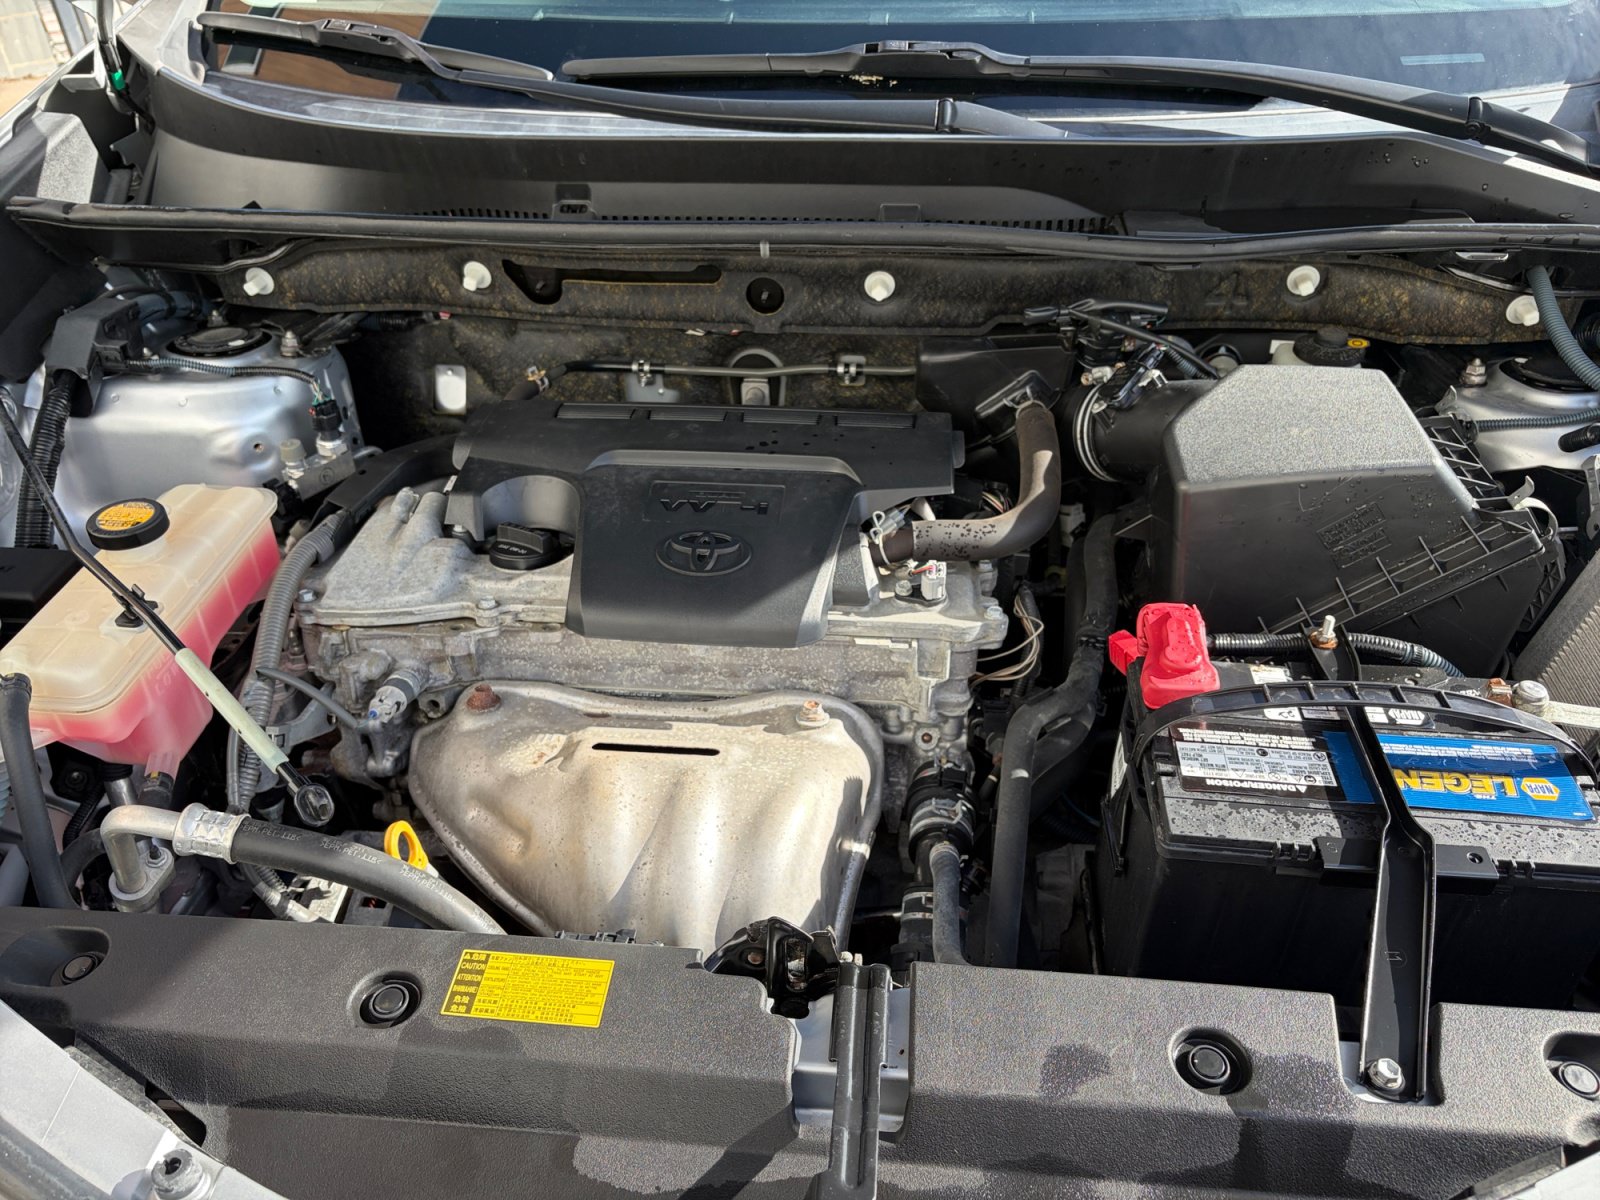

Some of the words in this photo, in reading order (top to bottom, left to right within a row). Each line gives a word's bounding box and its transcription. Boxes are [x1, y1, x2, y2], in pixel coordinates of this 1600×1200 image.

[1205, 779, 1297, 791] DANGER/POISON
[1392, 769, 1520, 798] LEGEN
[1525, 782, 1555, 795] NAPA
[460, 962, 487, 971] CAUTION
[456, 973, 483, 982] ATTENTION
